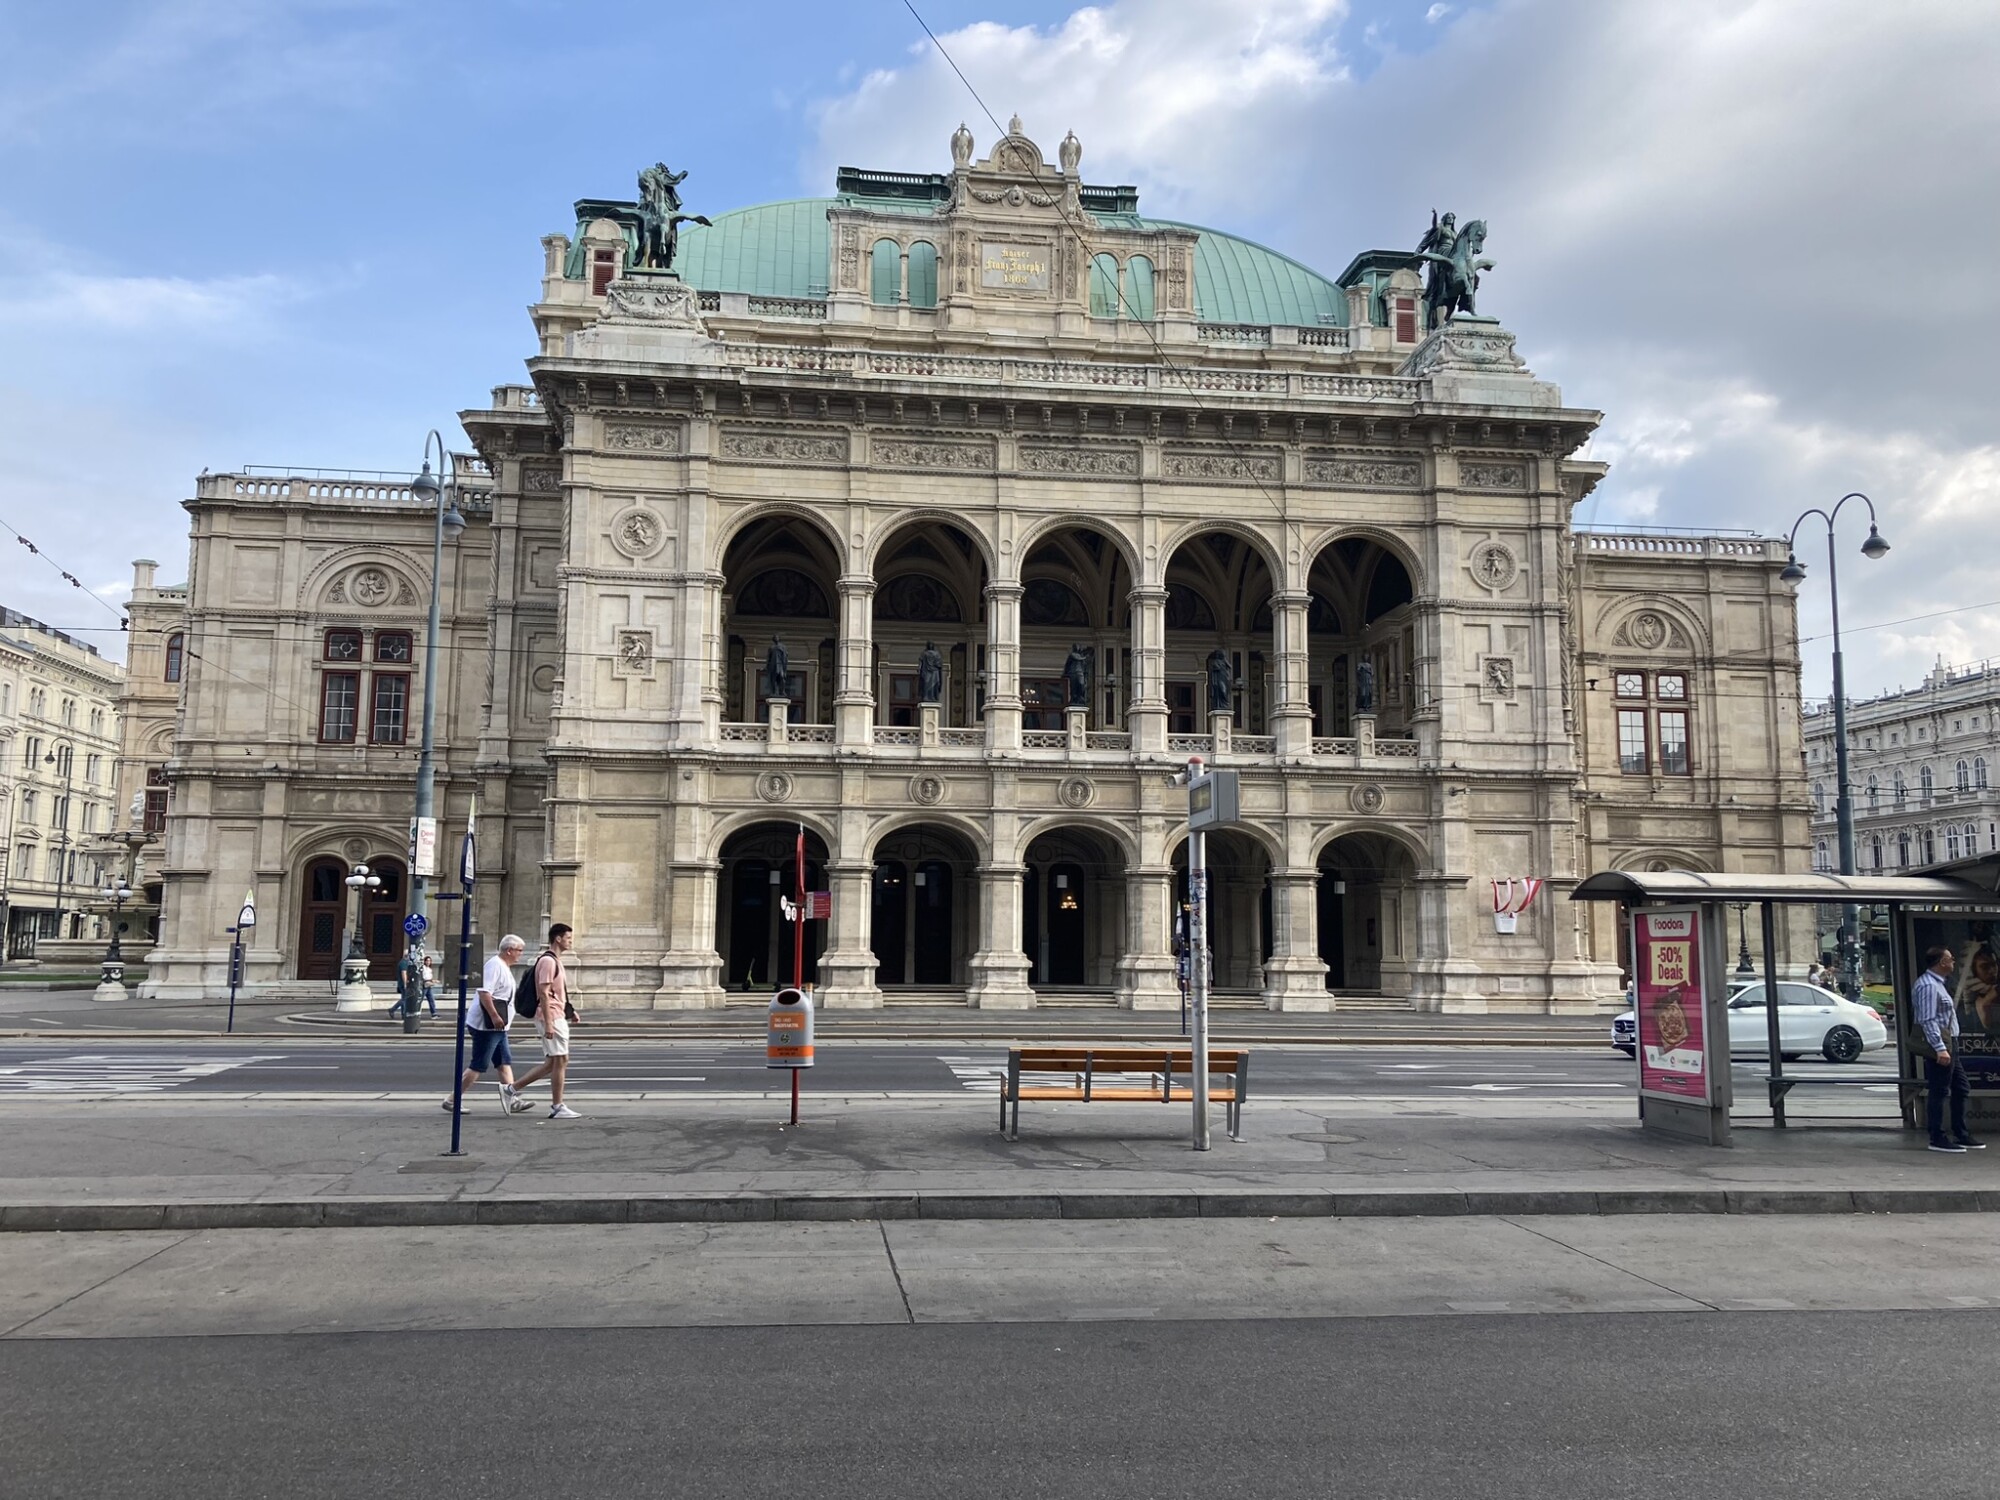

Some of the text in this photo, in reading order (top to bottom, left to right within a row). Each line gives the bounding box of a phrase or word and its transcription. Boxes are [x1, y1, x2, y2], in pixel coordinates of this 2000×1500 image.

[1001, 247, 1030, 258] Kaiser
[985, 257, 1009, 274] Franz
[1004, 274, 1027, 284] 1868
[1654, 918, 1684, 930] foodora
[1657, 947, 1683, 963] -50%
[1658, 964, 1684, 980] Deals
[1957, 1039, 2000, 1053] HSOKA
